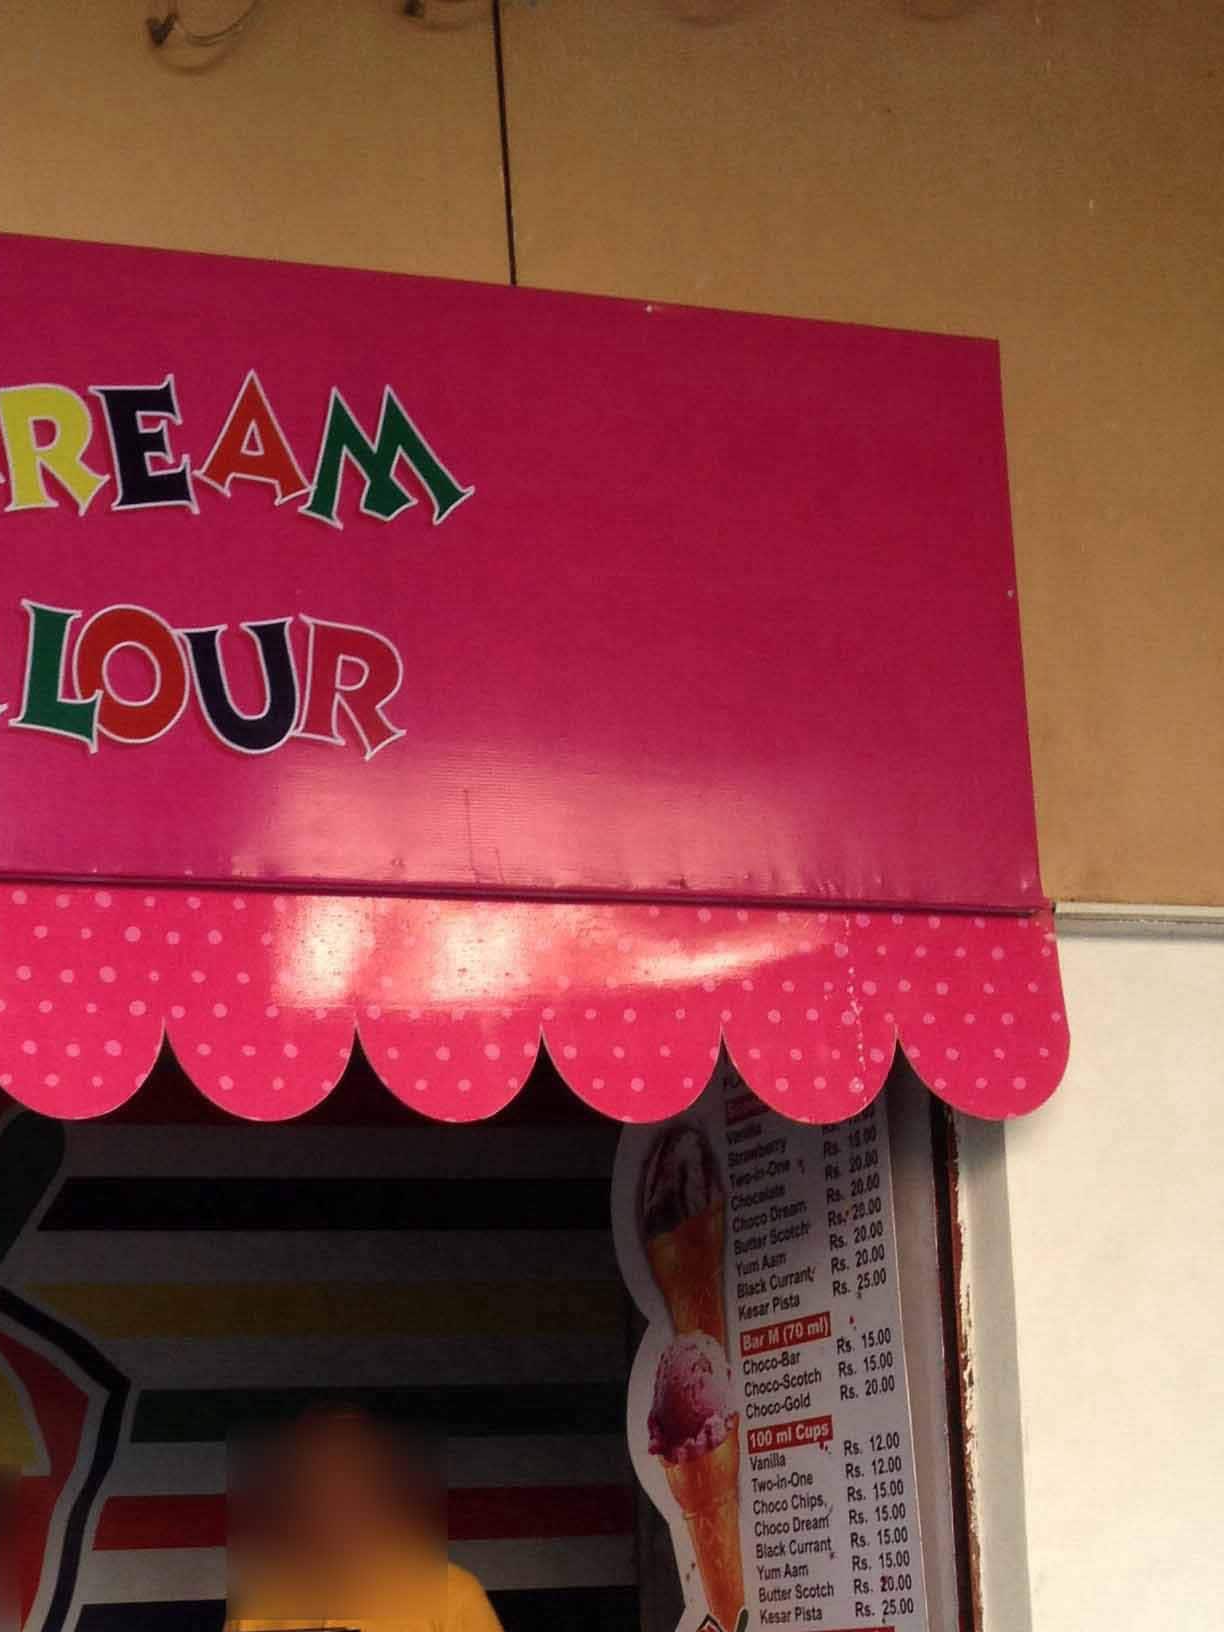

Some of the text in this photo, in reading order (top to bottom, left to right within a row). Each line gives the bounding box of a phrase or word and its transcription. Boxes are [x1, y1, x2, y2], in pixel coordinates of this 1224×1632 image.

[850, 1172, 880, 1196] 20.00
[852, 1196, 881, 1220] 20.00
[854, 1220, 883, 1243] 20.00
[737, 1278, 767, 1299] Black
[855, 1244, 884, 1267] 20.00
[738, 1301, 770, 1321] Kesar
[772, 1292, 800, 1312] Pista
[857, 1268, 886, 1290] 25.00
[742, 1334, 765, 1352] Bar
[783, 1322, 804, 1344] (70
[807, 1316, 828, 1337] ml)
[743, 1351, 800, 1375] Choco-Bar
[862, 1327, 891, 1348] 15.00
[745, 1351, 893, 1397] Choco-Scotch Rs. 15.00
[746, 1375, 895, 1418] Choco-Gold Rs. 20.00
[749, 1452, 786, 1471] Vanilla
[870, 1432, 900, 1451] 12.00
[750, 1423, 829, 1448] 100 ml Cups
[752, 1456, 902, 1493] Two-in-One Rs. 12.00
[753, 1499, 788, 1515] Choco
[848, 1486, 866, 1502] Rs.
[873, 1479, 904, 1500] 15.00
[755, 1502, 905, 1536] Choco Dream Rs. 15.00
[756, 1526, 908, 1559] Black Currant Rs. 15.00
[757, 1550, 910, 1580] Yum Aam Rs. 15.00
[759, 1574, 912, 1602] Butter Scotch Rs. 20.00
[760, 1598, 914, 1624] Kesar Pista Rs. 25.00
